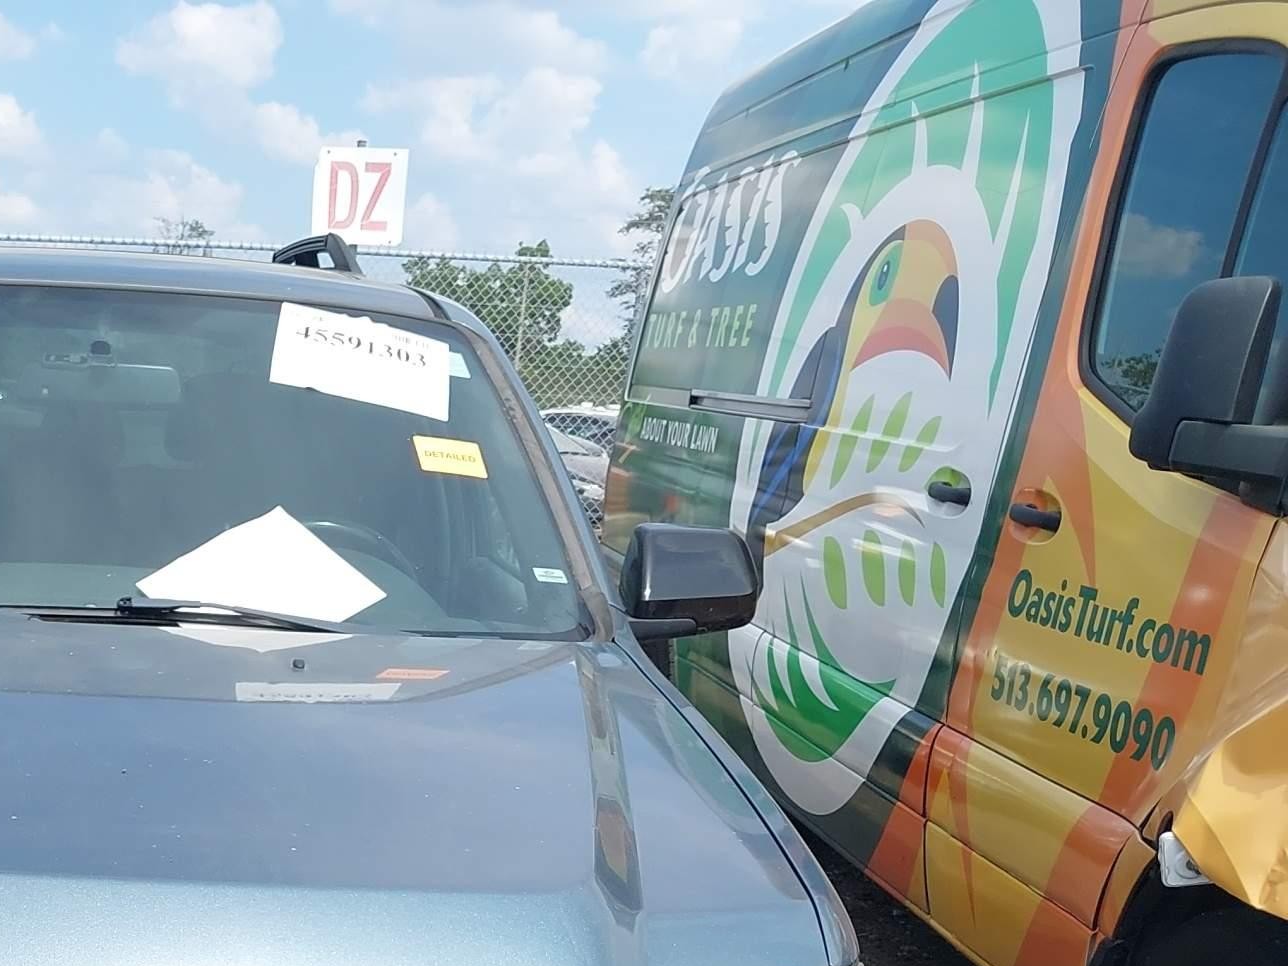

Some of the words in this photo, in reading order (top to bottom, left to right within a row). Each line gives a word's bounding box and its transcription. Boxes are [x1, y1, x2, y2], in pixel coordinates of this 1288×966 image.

[327, 160, 393, 232] DZ
[661, 150, 802, 294] OASIS
[295, 326, 429, 368] 45591303
[645, 310, 688, 349] TURF
[687, 308, 703, 349] &
[705, 303, 758, 348] TREE
[640, 417, 668, 443] ABOUT
[666, 421, 691, 448] YOUR
[689, 424, 720, 453] LAWN
[1007, 569, 1212, 677] OasisTurf.com
[990, 656, 1177, 772] 513.697.9090
